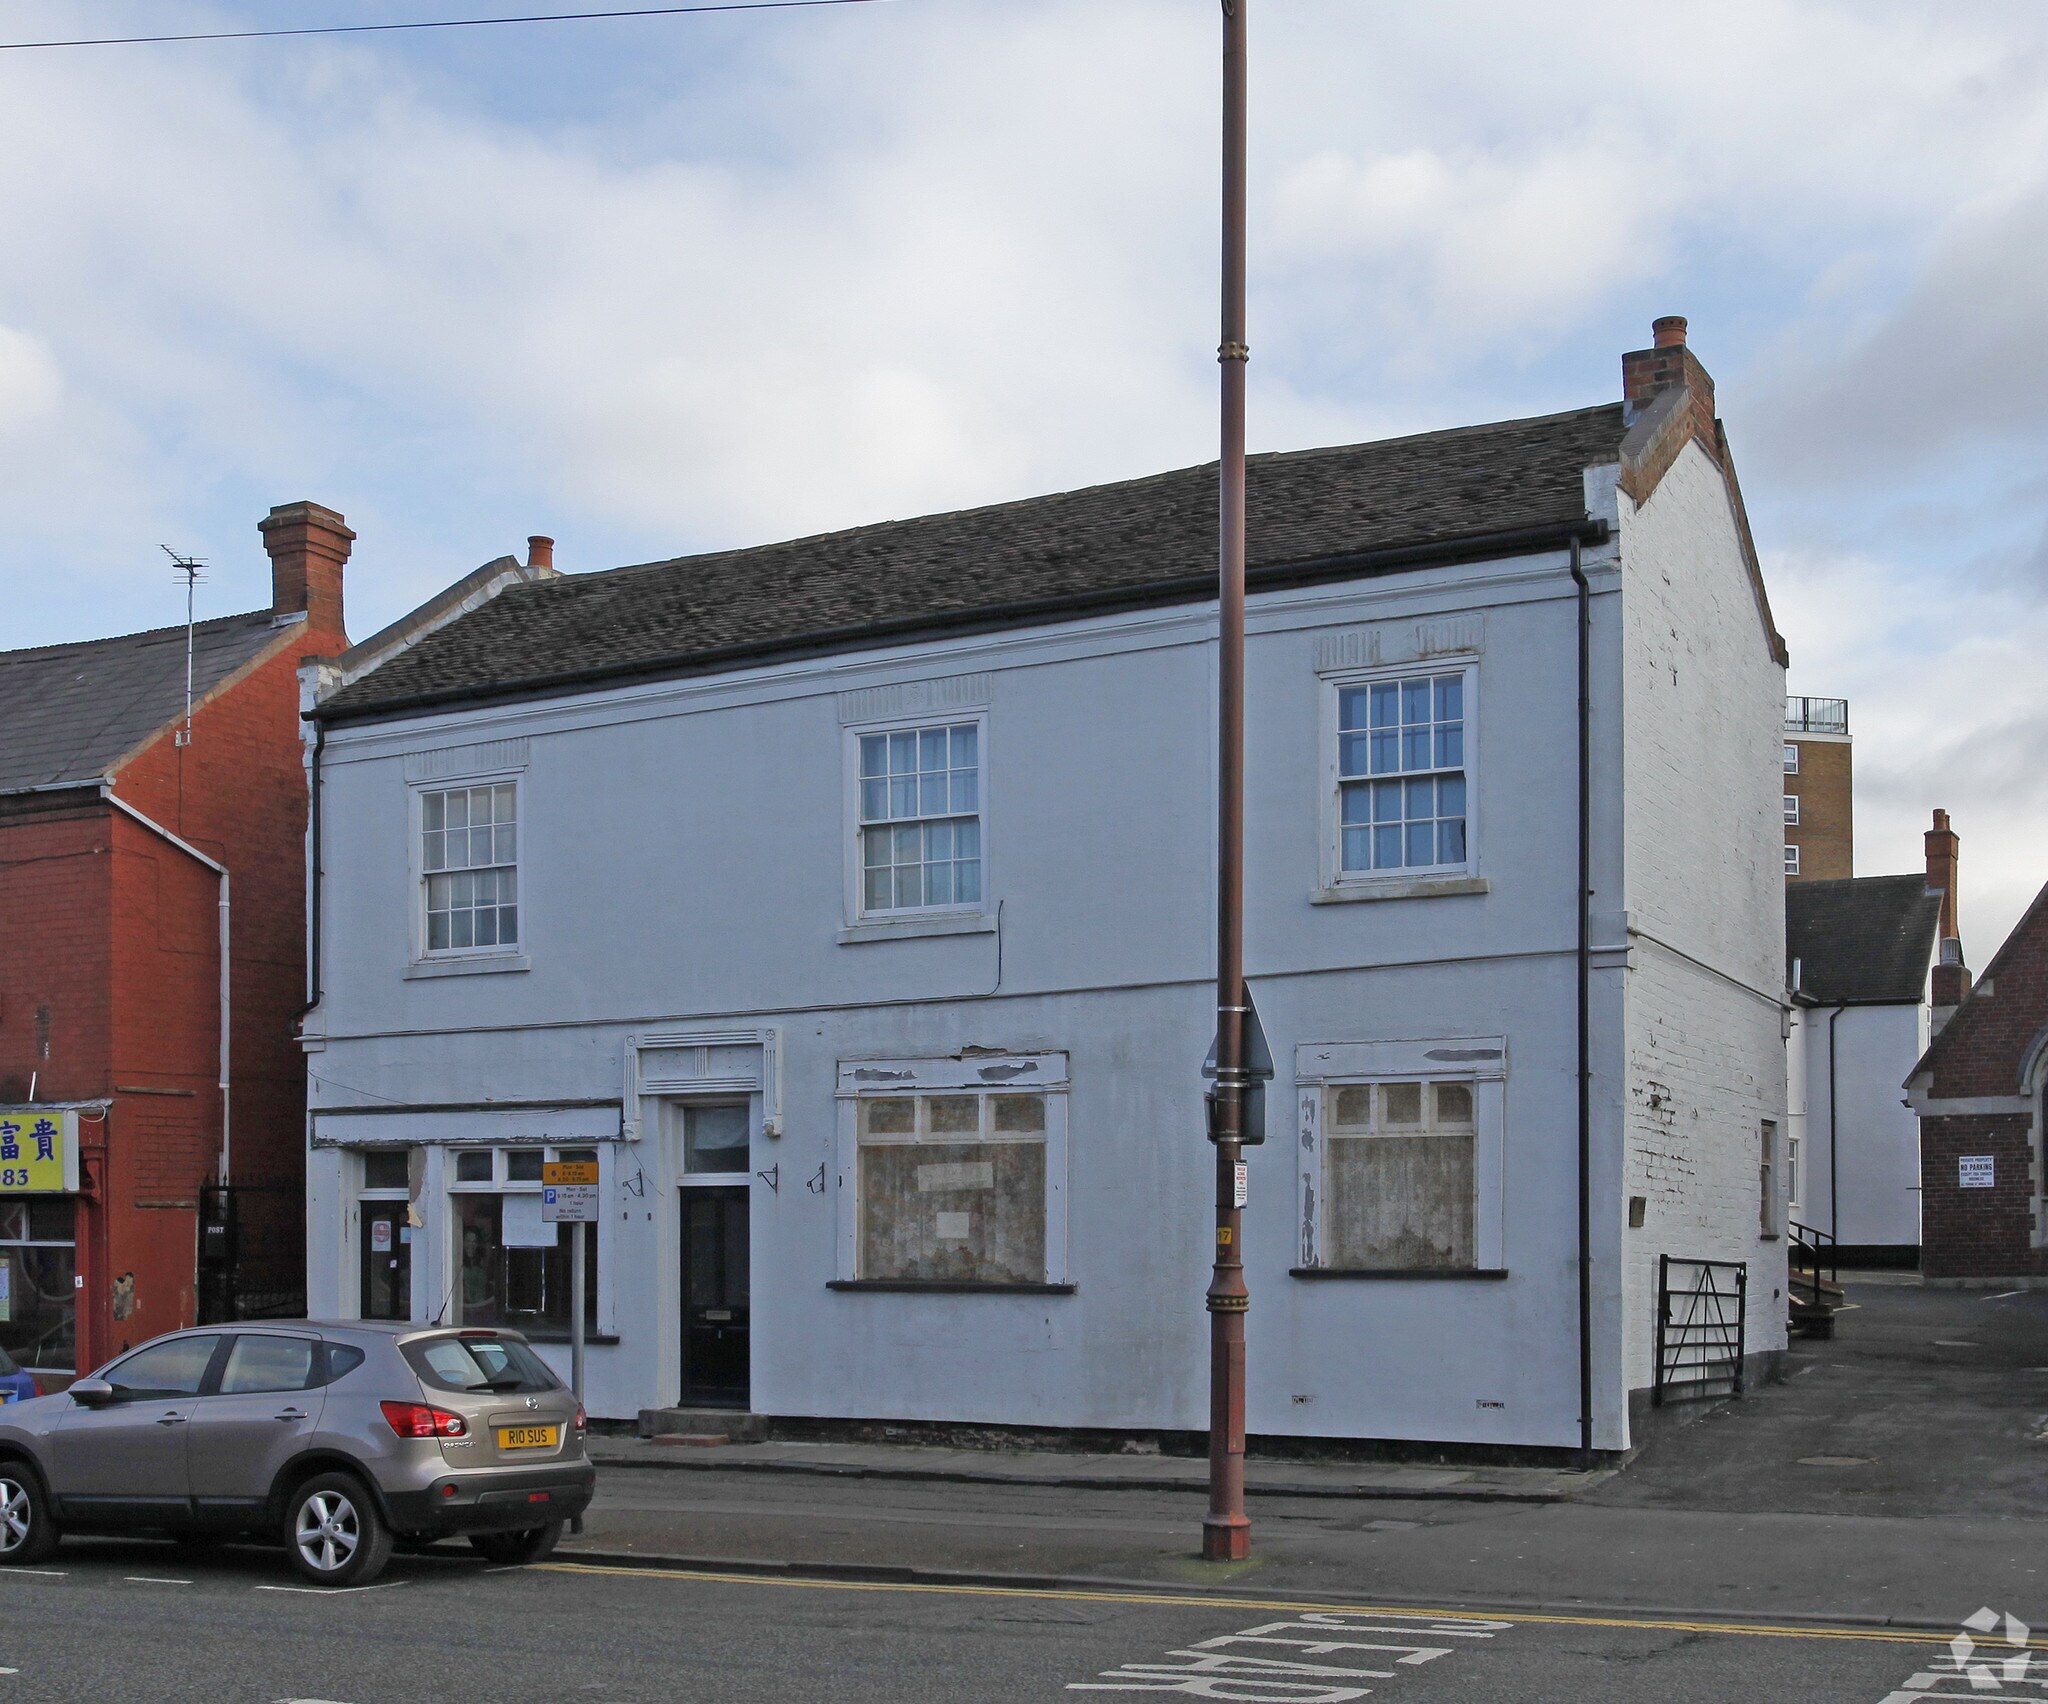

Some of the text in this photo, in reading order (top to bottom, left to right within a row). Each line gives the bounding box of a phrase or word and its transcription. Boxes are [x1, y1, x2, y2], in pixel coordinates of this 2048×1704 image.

[0, 1168, 29, 1186] 83
[528, 1429, 547, 1443] SUS
[1064, 1611, 1515, 1704] CLEAR
